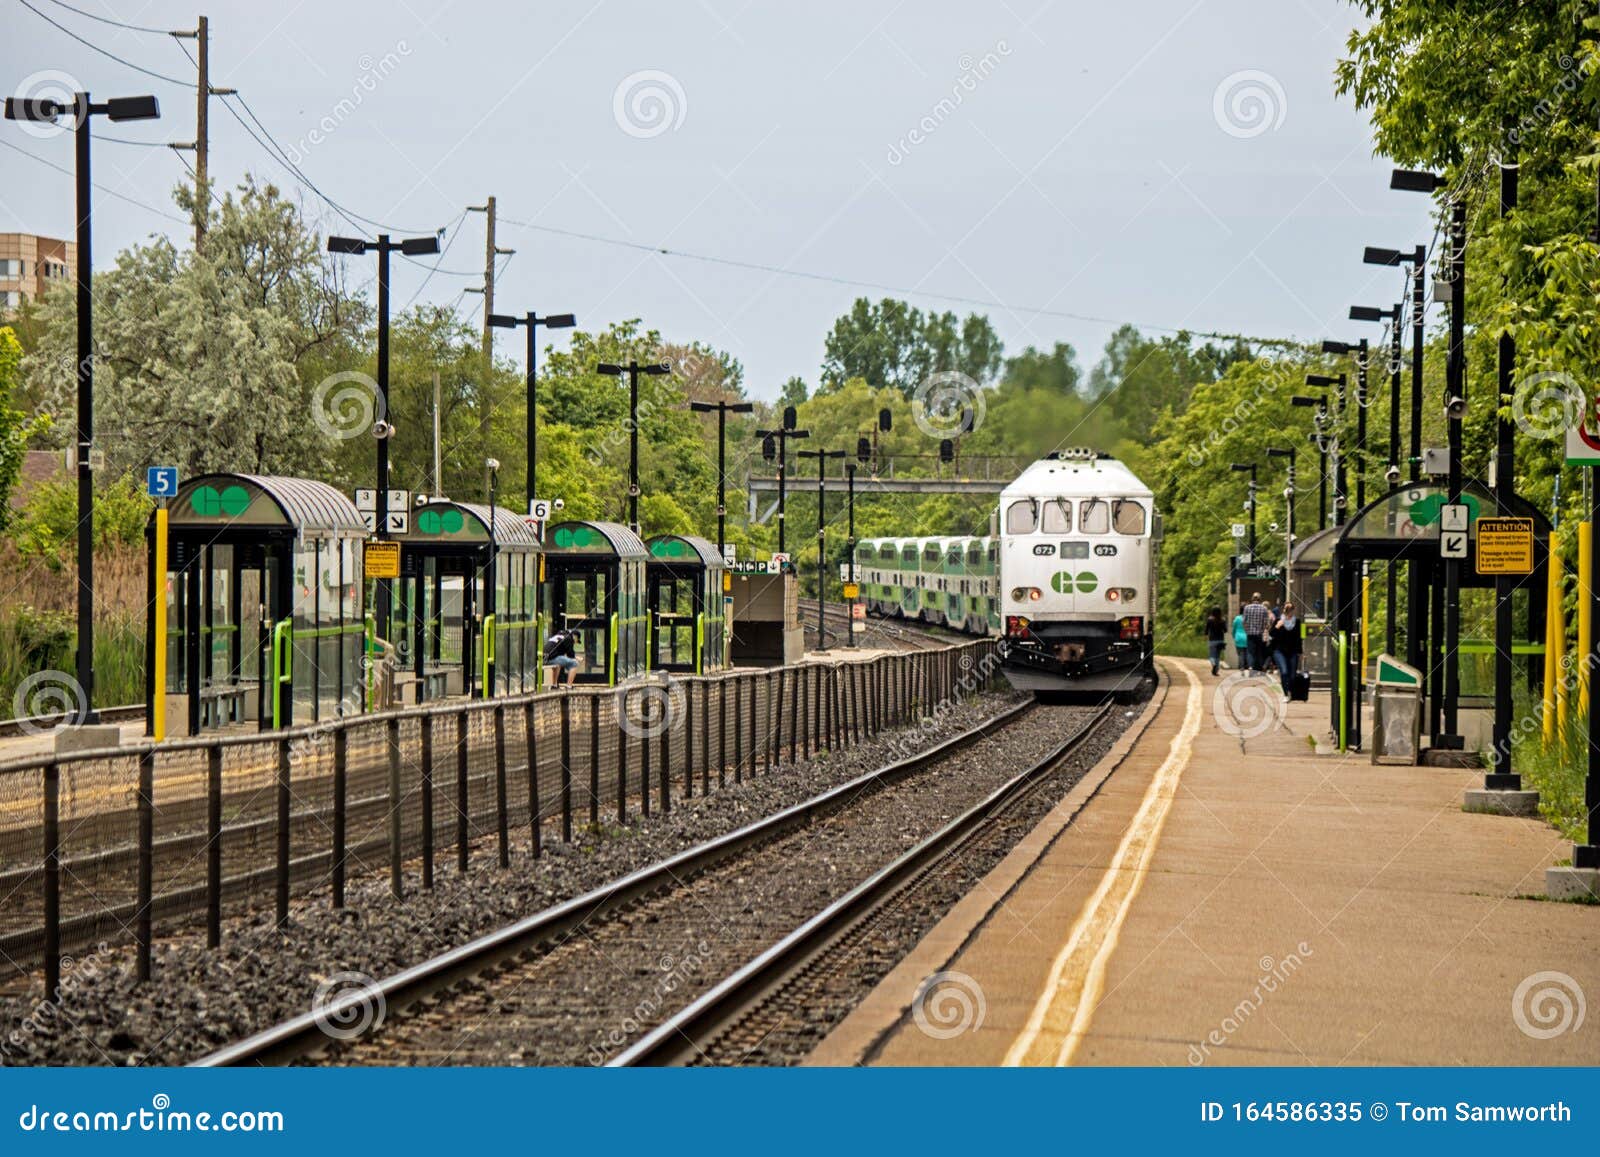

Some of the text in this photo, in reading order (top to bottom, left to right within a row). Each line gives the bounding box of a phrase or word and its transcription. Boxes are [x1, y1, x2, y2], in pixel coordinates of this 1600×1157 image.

[157, 471, 169, 492] 5
[363, 491, 370, 501] 3
[395, 491, 402, 501] 2
[535, 503, 546, 517] 6
[1451, 508, 1457, 519] 1
[1481, 523, 1530, 531] ATTENTION
[1035, 546, 1054, 555] 671
[1096, 546, 1116, 555] 671
[1050, 571, 1098, 594] GO
